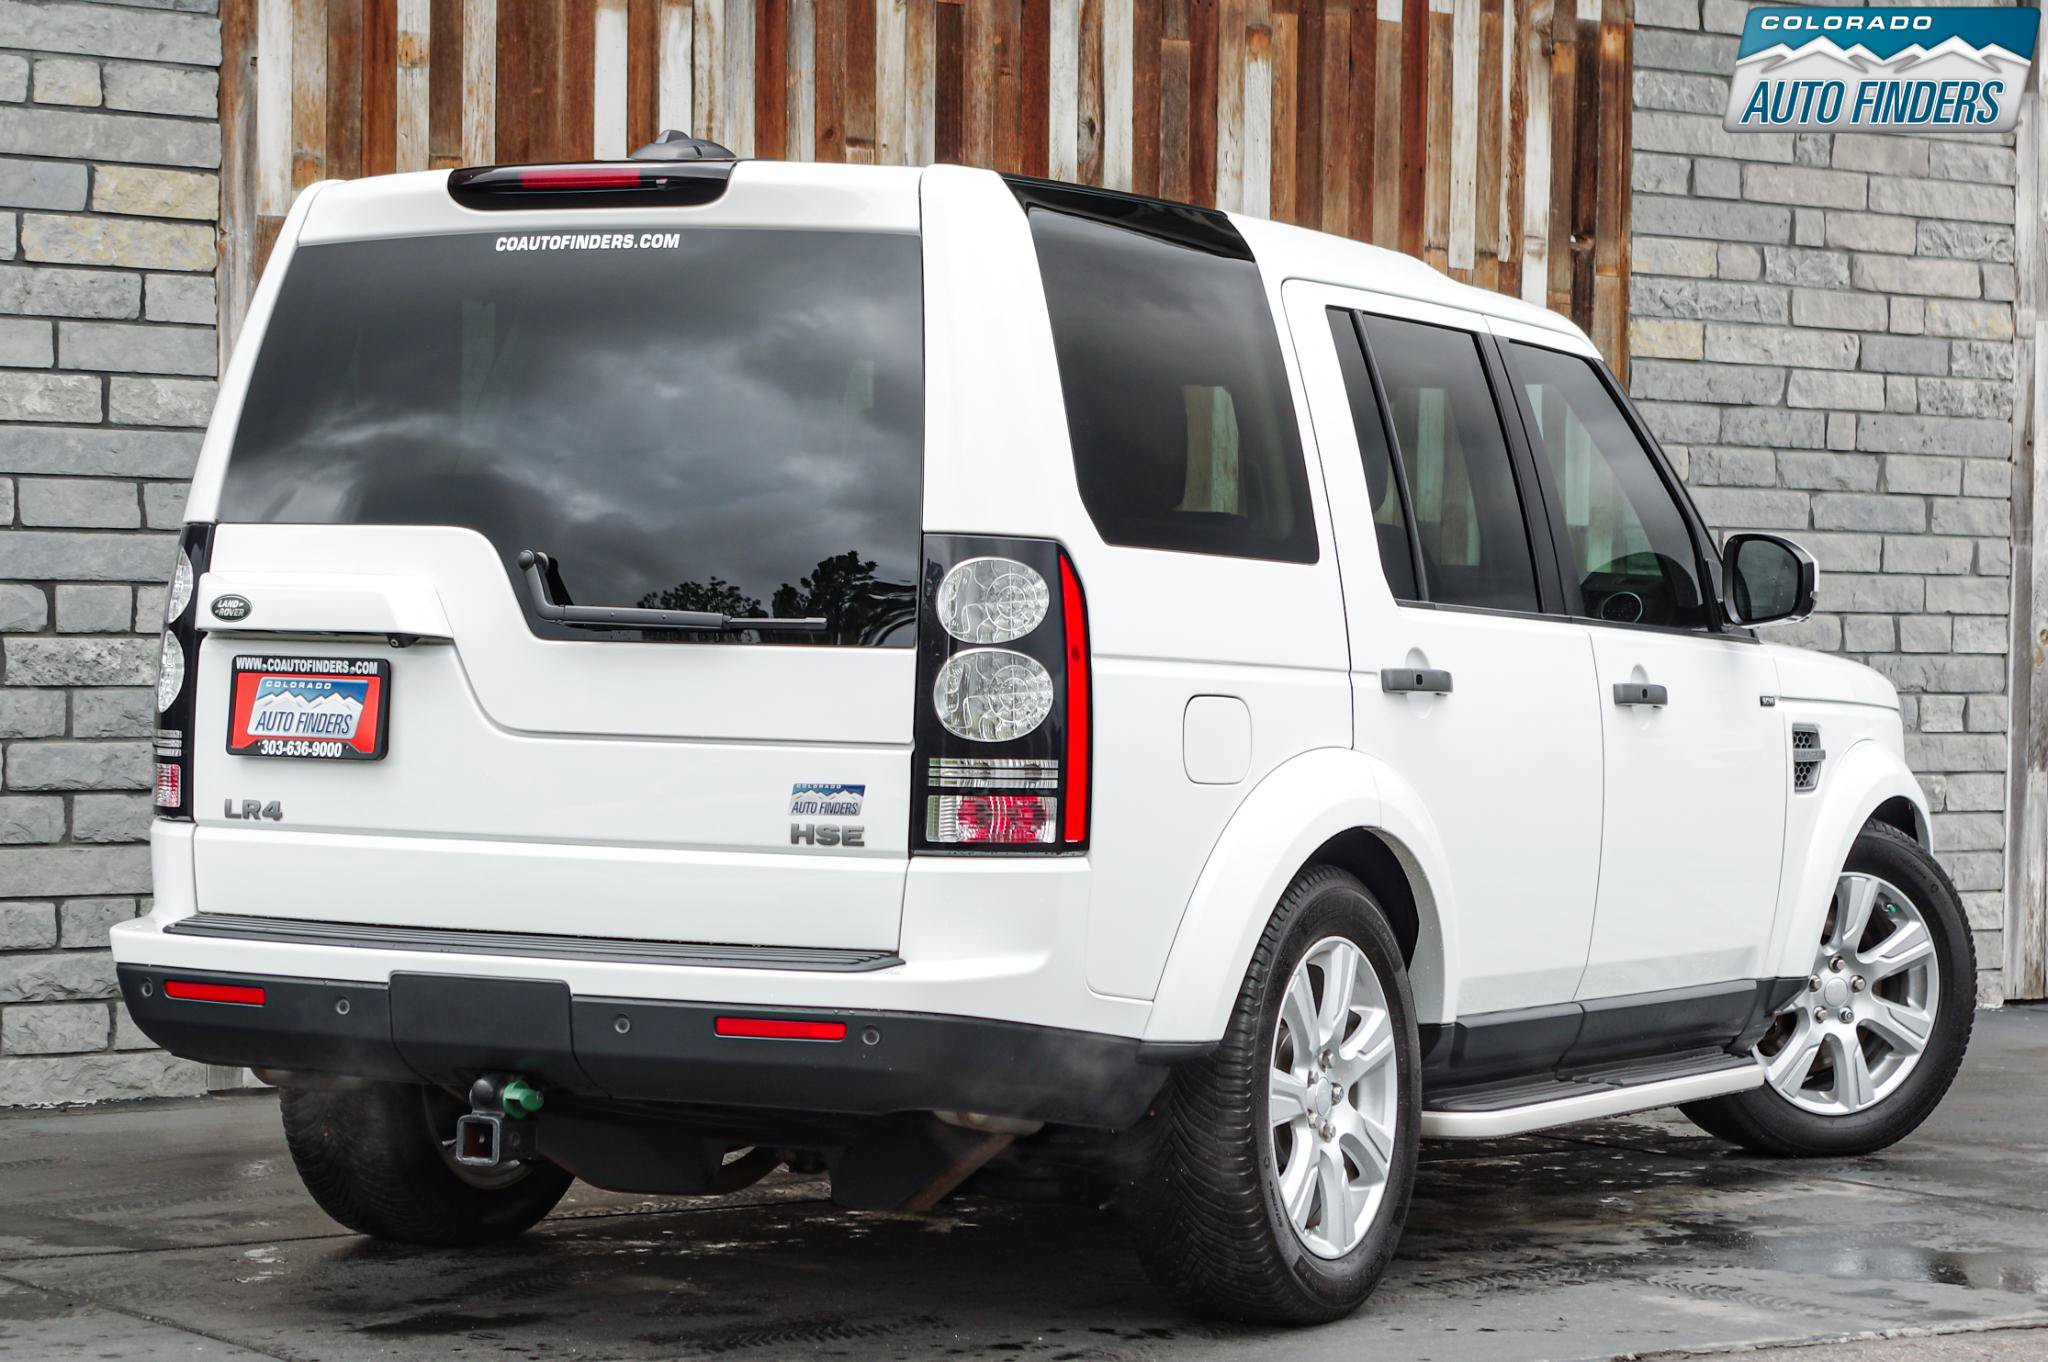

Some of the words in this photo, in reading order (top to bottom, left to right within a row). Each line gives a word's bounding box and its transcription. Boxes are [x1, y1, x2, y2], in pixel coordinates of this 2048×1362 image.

[495, 233, 681, 252] COAUTOFINDERS.COM
[217, 599, 240, 608] LAND
[218, 608, 245, 617] ROVER
[235, 657, 378, 675] WWW.COAUTOFINDERS.COM
[265, 680, 332, 690] COLORADO
[255, 711, 295, 732] AUTO
[296, 711, 353, 735] FINDERS
[260, 739, 343, 758] 303-636-9000
[224, 798, 283, 821] LR4
[791, 801, 818, 814] AUTO
[819, 801, 859, 815] FINDERS
[790, 822, 865, 847] HSE
